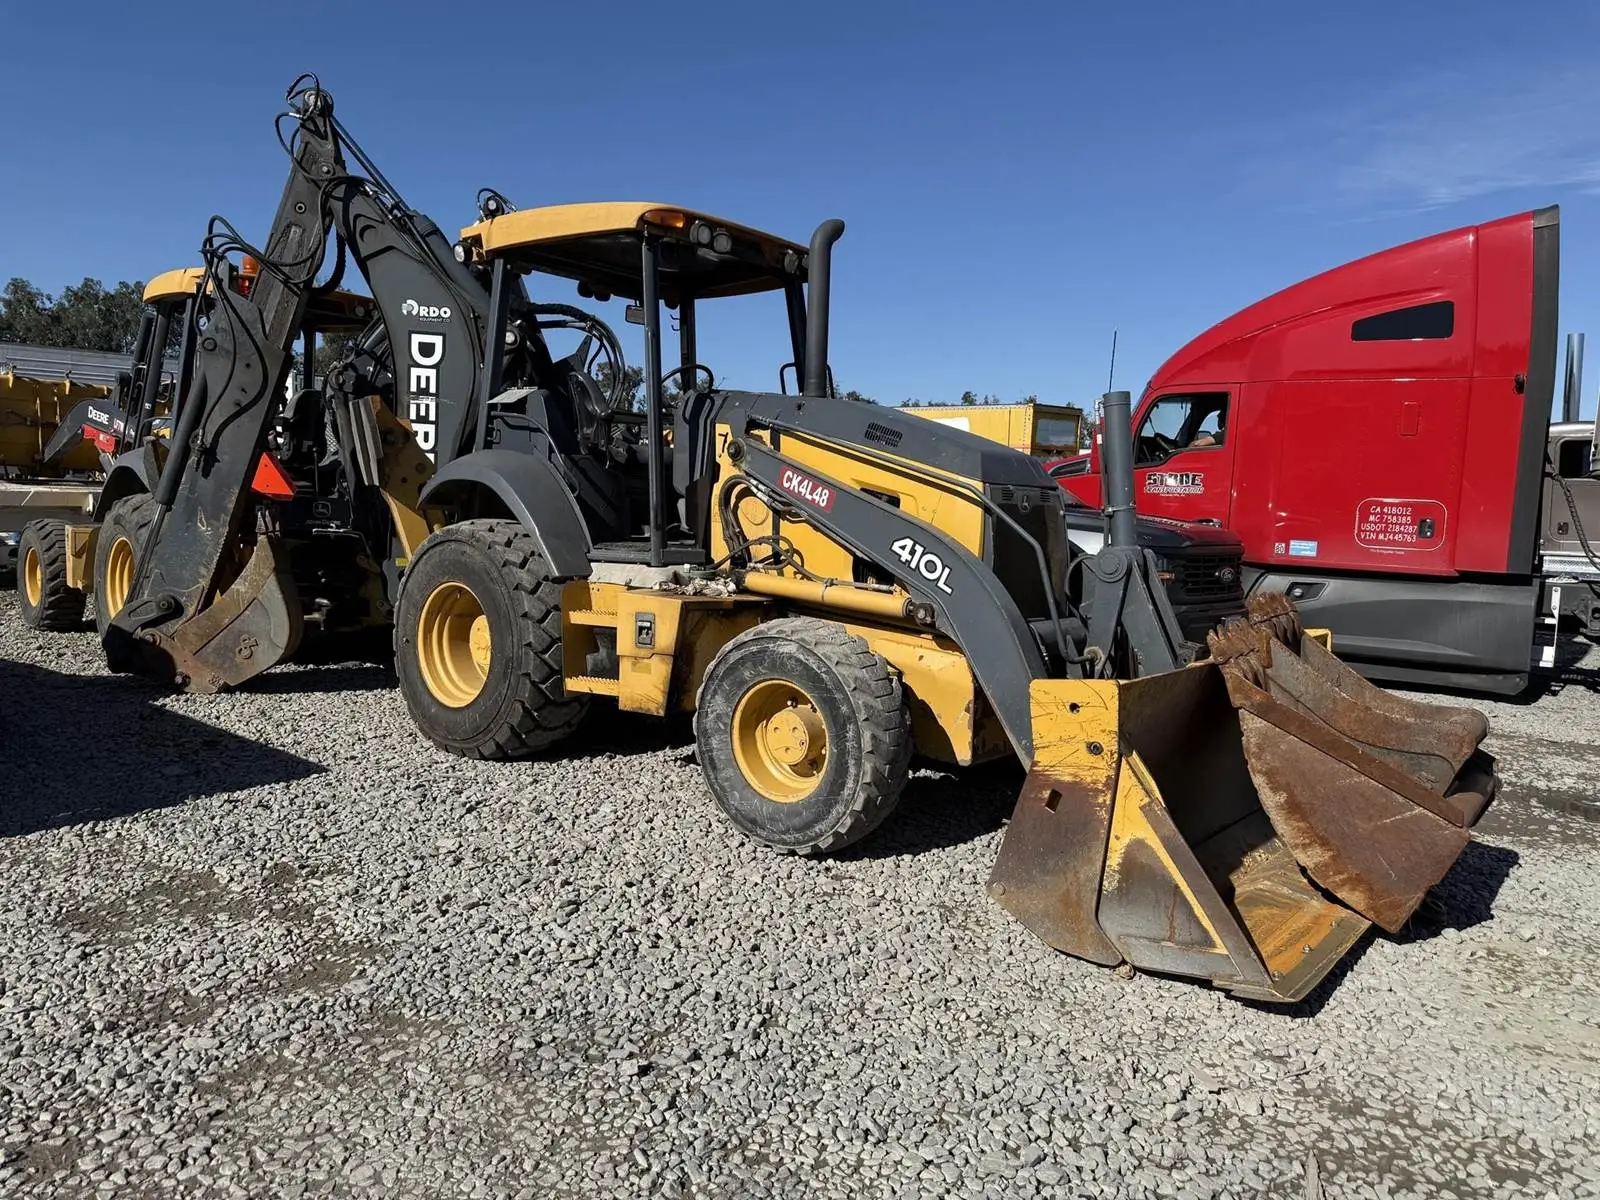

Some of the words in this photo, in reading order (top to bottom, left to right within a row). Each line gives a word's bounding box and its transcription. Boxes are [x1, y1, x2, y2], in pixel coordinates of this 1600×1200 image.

[420, 306, 451, 318] RDO
[409, 333, 443, 465] DEER
[88, 405, 110, 425] DEERE
[782, 470, 830, 508] CK4L48
[1383, 506, 1412, 515] 418012
[1383, 515, 1412, 524] 758385
[1361, 523, 1386, 531] USDOT
[1388, 524, 1418, 533] 2184287
[1360, 532, 1377, 540] VIN
[890, 536, 954, 595] 410L
